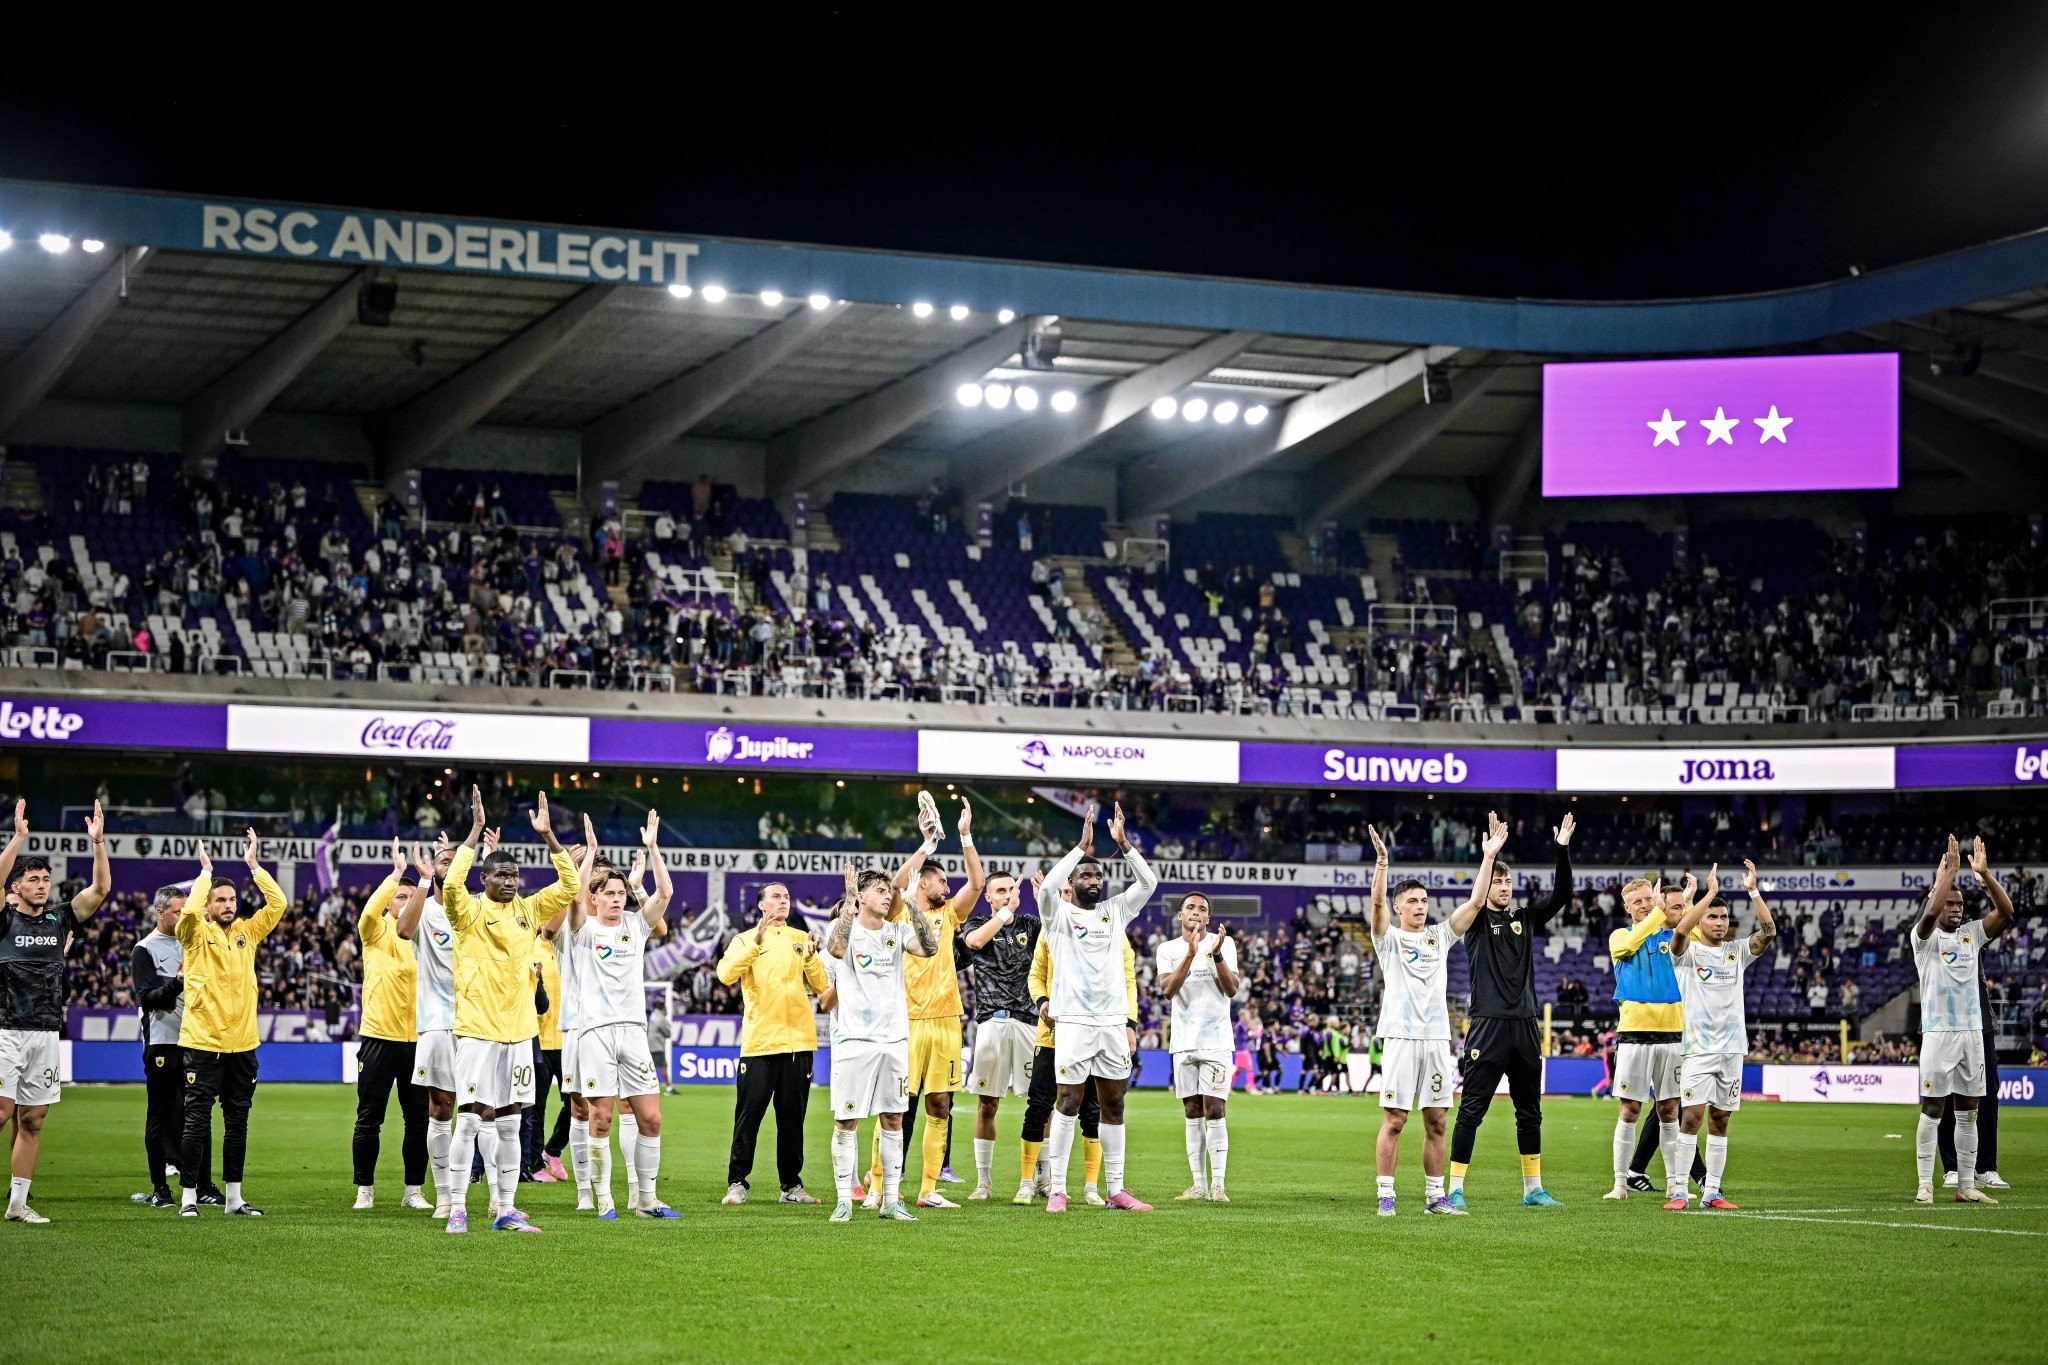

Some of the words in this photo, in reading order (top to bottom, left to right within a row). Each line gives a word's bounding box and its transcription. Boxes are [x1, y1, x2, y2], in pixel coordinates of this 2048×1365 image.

[203, 205, 318, 256] RSC
[329, 215, 698, 283] ANDERLECHT
[734, 735, 814, 762] Jupiler
[1063, 746, 1145, 760] NAPOLEON
[1323, 749, 1468, 784] Sunweb
[29, 838, 120, 853] DURBY
[161, 839, 270, 858] ADVENTUE
[1159, 863, 1216, 881] VALLEY
[1223, 867, 1297, 881] DURBUY
[15, 935, 57, 947] gpexe
[680, 1052, 738, 1079] Sun
[949, 1060, 955, 1079] 1
[513, 1065, 532, 1087] 90
[1431, 1073, 1443, 1093] 3
[1836, 1074, 1882, 1085] NAPOLEON
[1997, 1075, 2035, 1100] web
